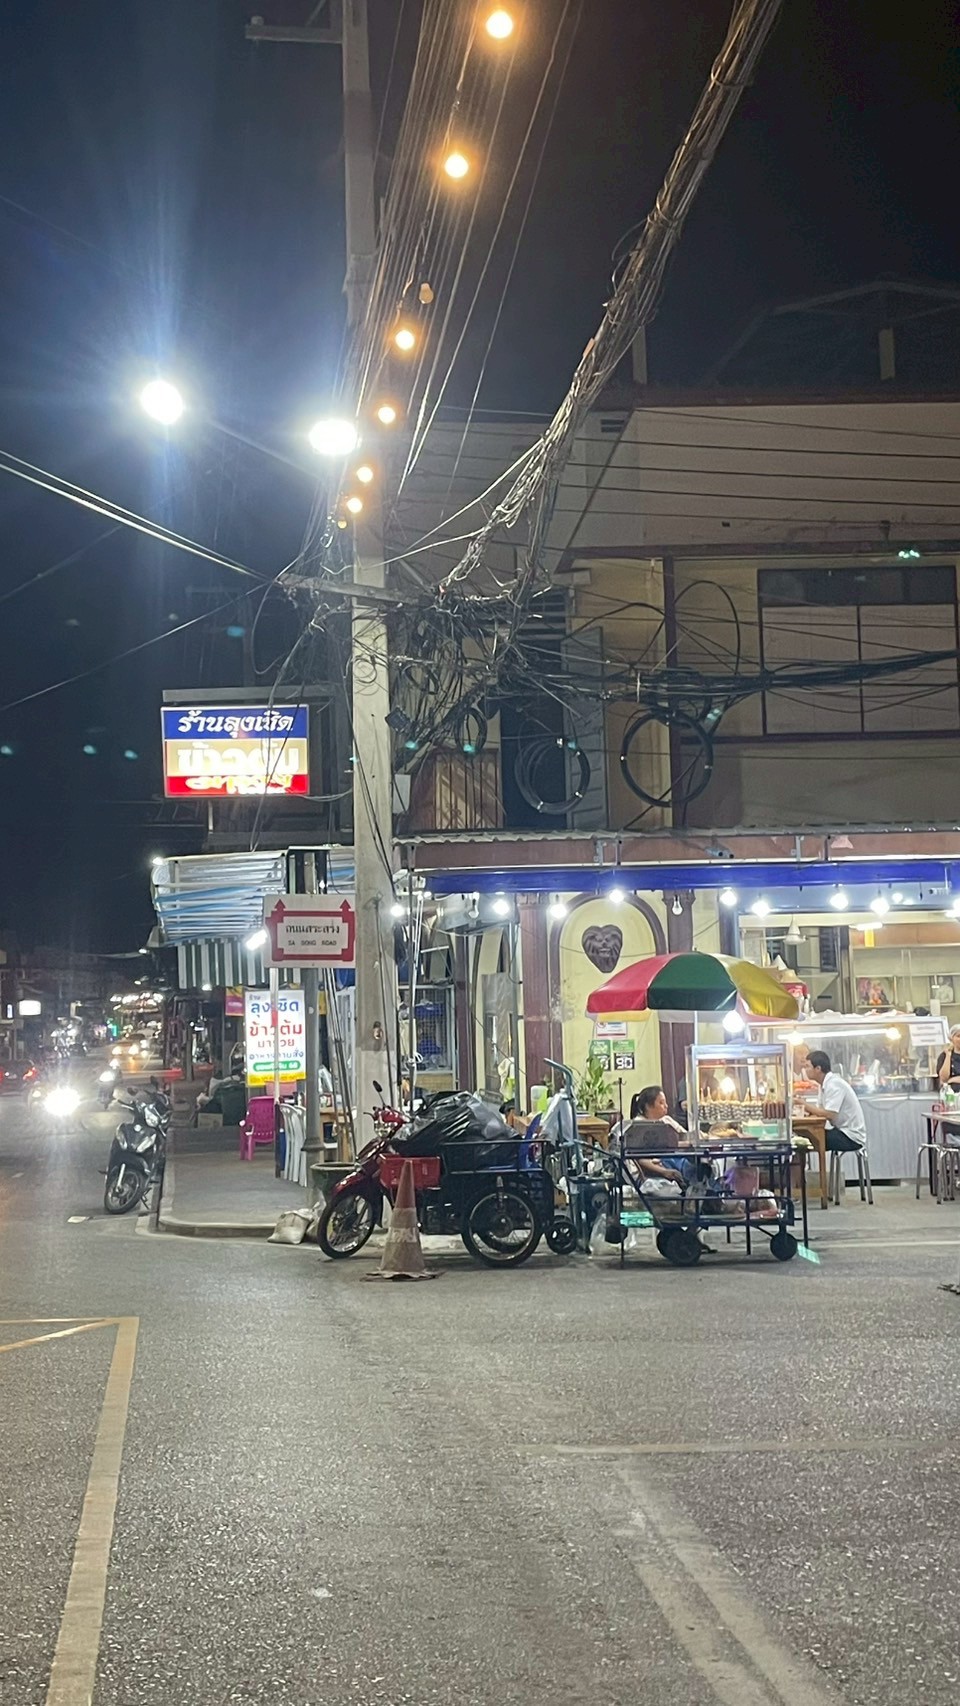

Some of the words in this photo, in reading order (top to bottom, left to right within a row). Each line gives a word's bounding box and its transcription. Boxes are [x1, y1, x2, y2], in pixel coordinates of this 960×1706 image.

[250, 997, 300, 1018] ลุงชิด
[257, 1038, 295, 1048] มาวย
